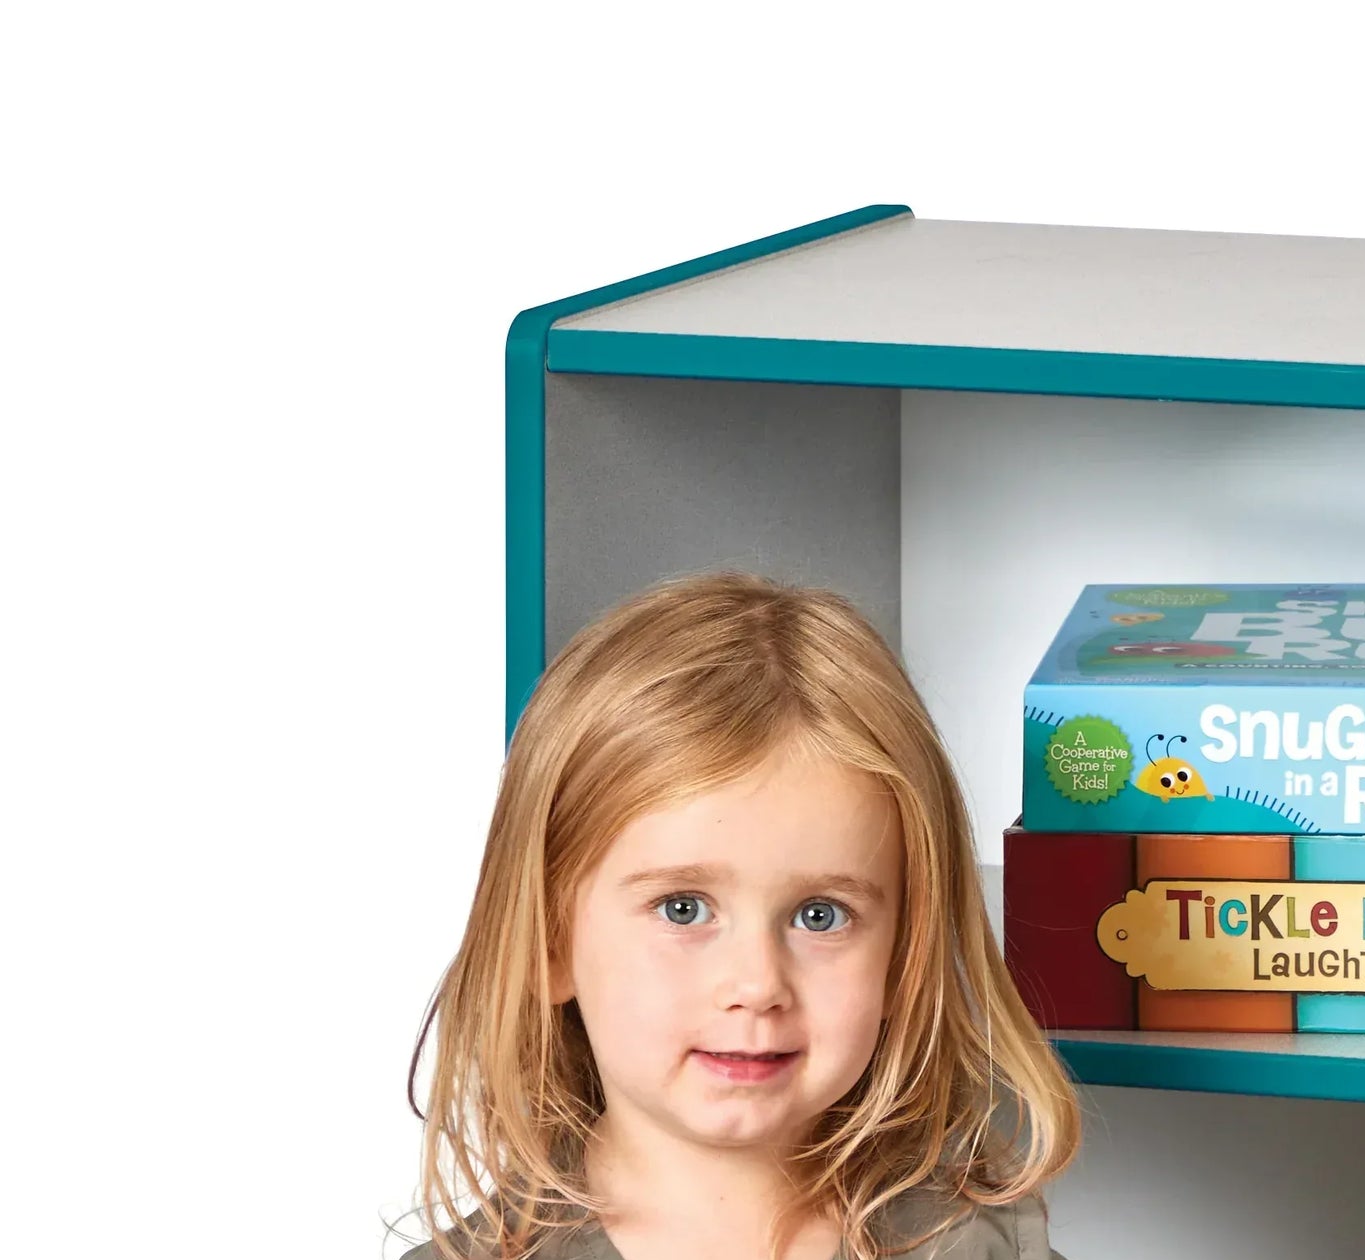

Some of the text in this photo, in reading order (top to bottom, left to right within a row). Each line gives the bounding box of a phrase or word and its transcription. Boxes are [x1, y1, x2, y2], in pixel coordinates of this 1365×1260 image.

[1074, 731, 1087, 746] A
[1050, 743, 1128, 760] Cooperative
[1059, 759, 1117, 774] Game for
[1072, 773, 1108, 790] Kids!
[1284, 771, 1312, 796] in
[1320, 771, 1338, 796] a
